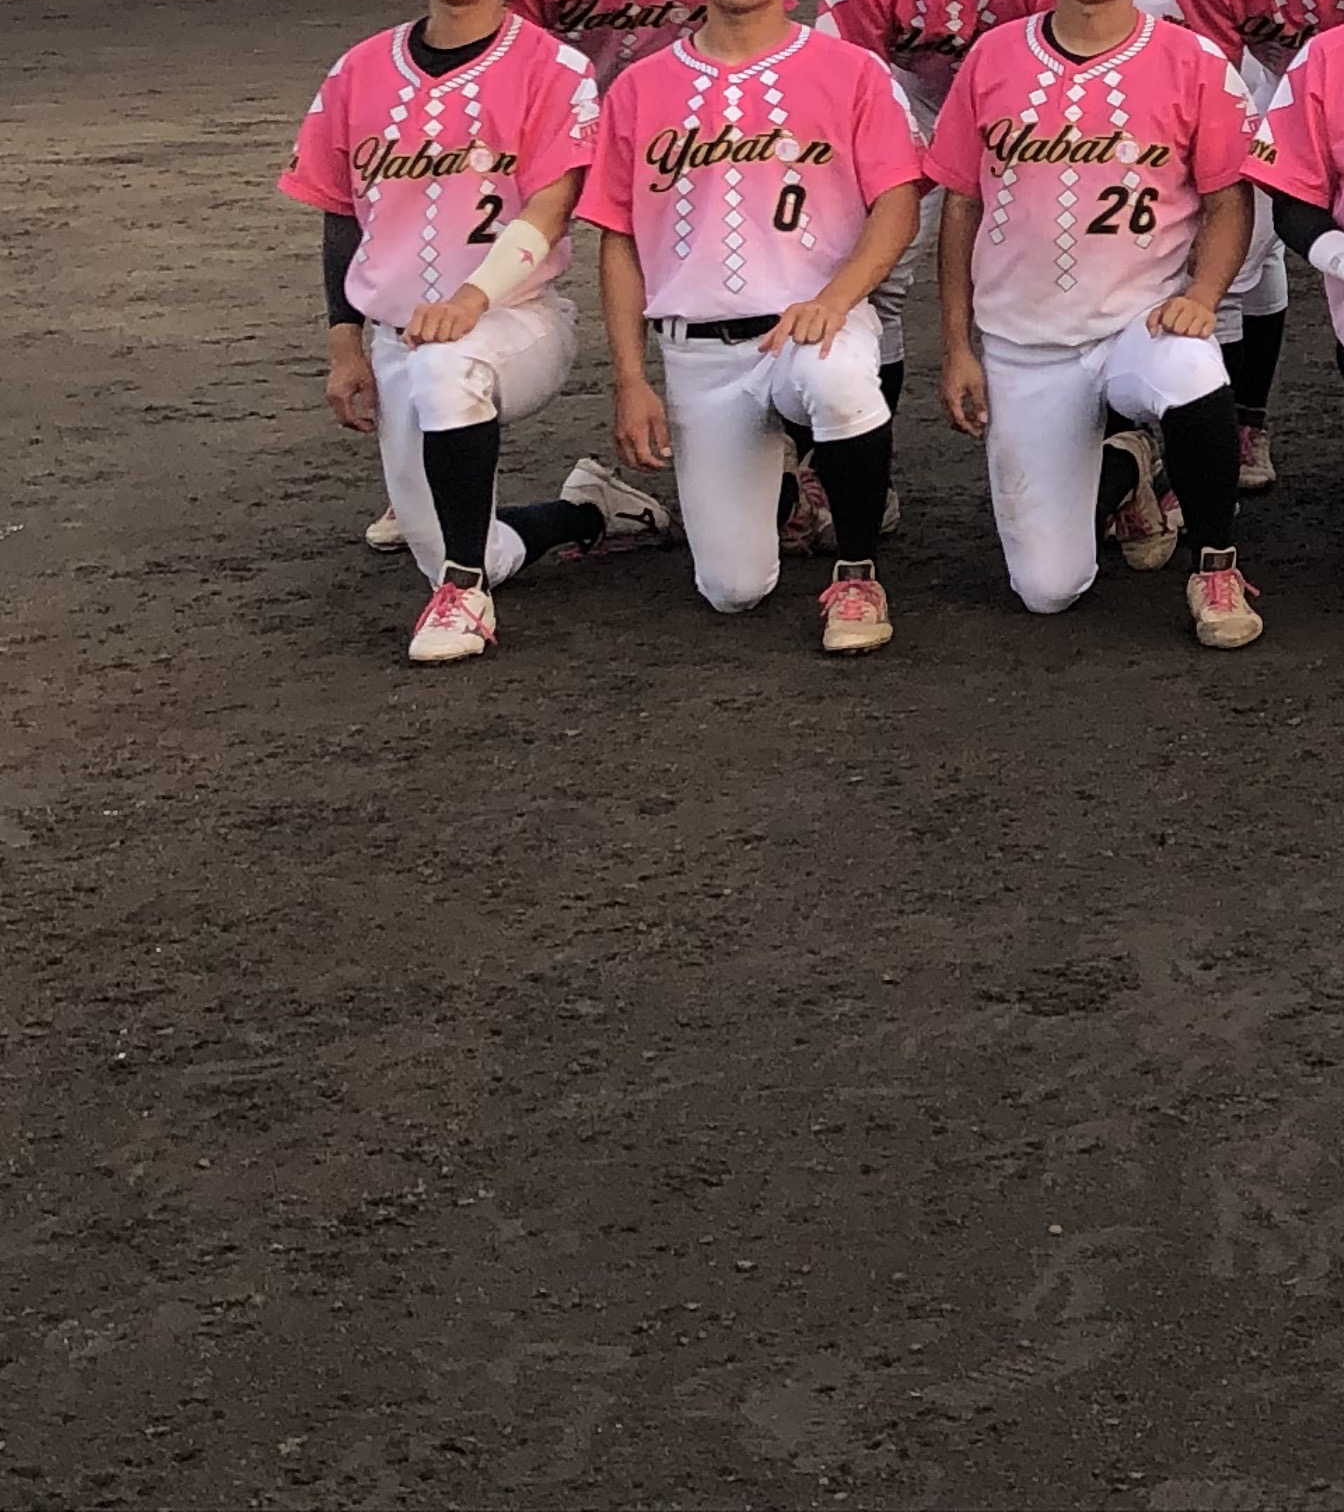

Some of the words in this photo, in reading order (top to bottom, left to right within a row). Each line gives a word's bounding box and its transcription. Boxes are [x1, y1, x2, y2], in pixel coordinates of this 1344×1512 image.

[354, 137, 517, 197] Yabaton
[647, 127, 832, 192] Yabaton
[986, 118, 1170, 178] Yabaton
[467, 195, 503, 245] 2
[773, 184, 806, 232] 0
[1086, 186, 1159, 235] 26
